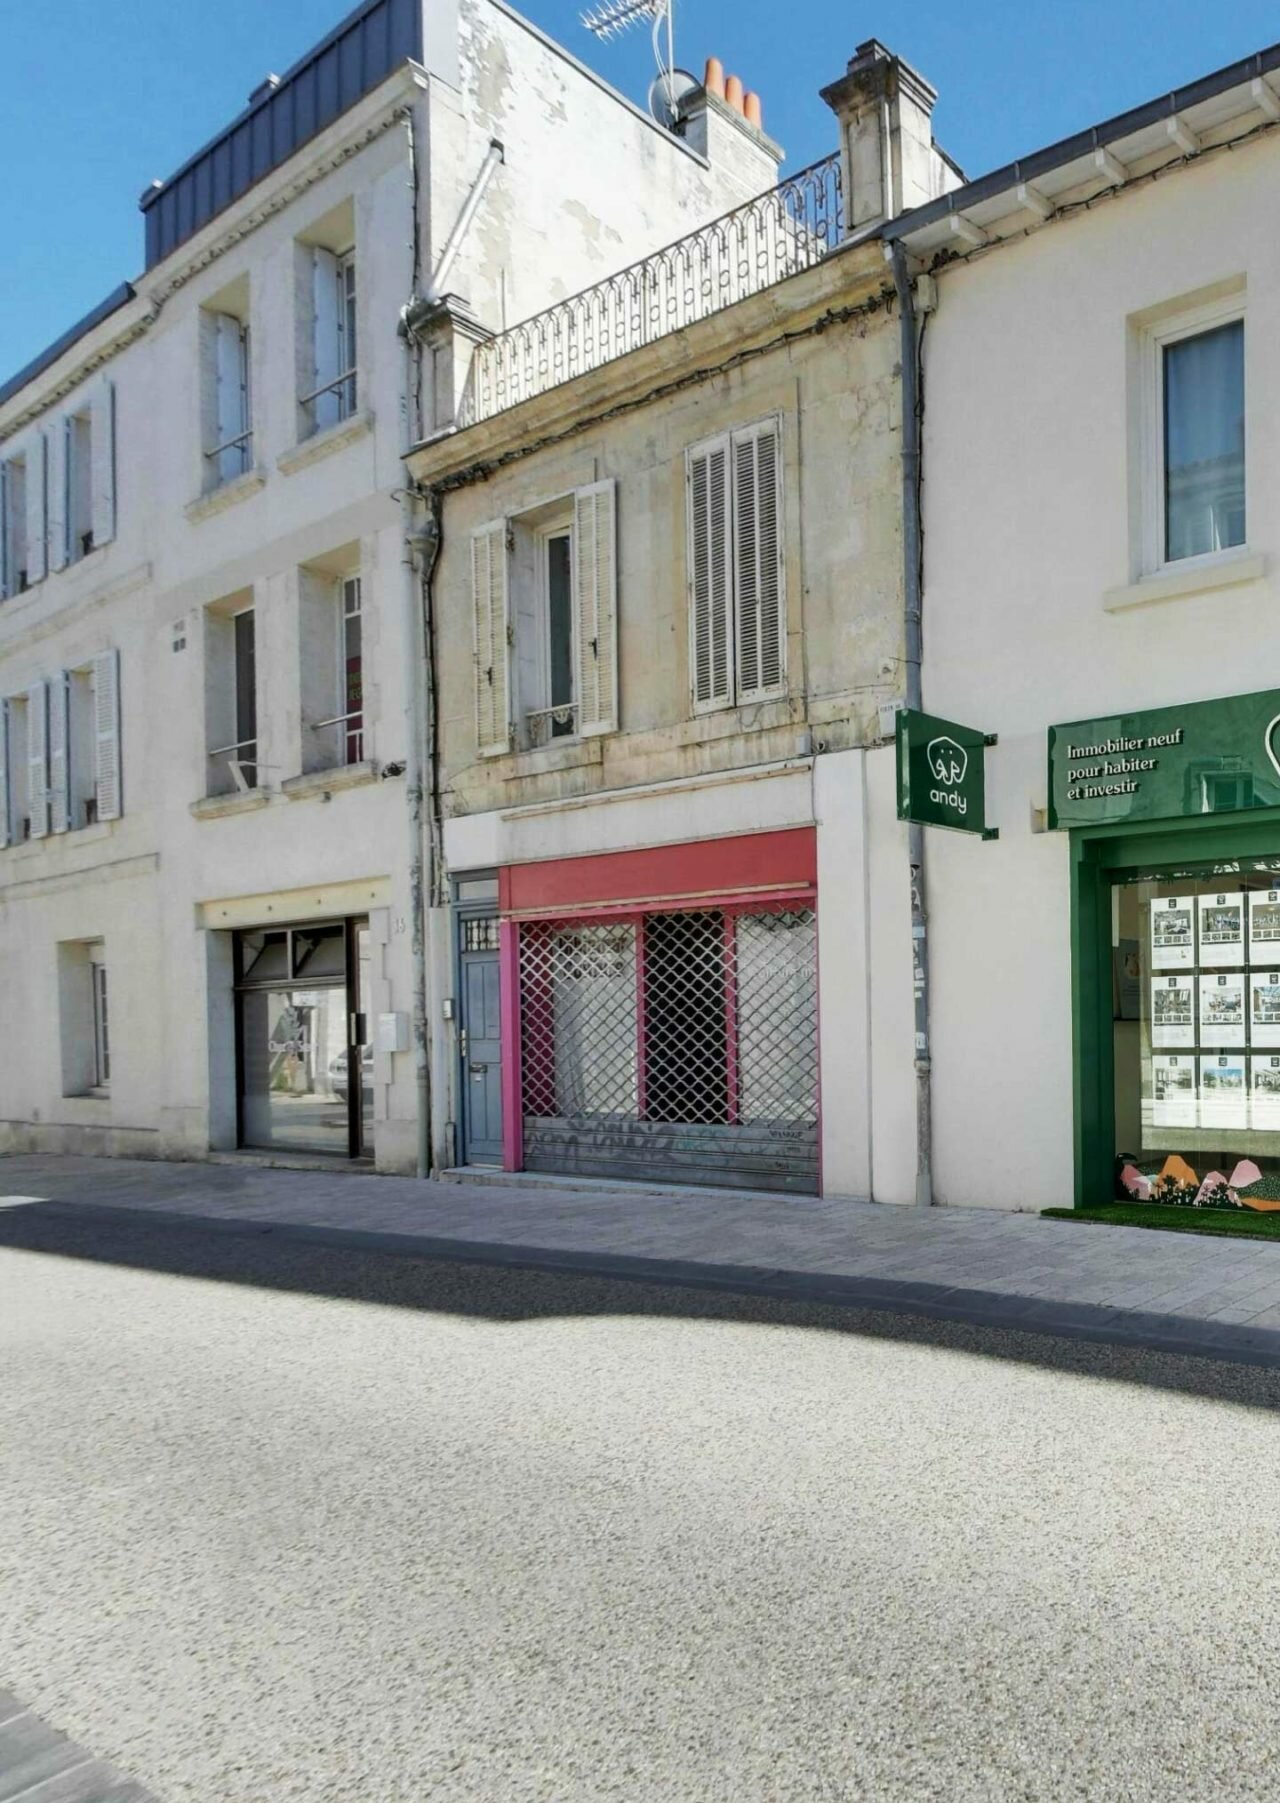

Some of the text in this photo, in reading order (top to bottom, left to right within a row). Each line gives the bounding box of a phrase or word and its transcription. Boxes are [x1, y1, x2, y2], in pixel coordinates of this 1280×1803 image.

[1067, 728, 1183, 759] Immobilier neuf
[1067, 758, 1156, 783] pour habiter
[930, 789, 967, 814] andy
[1067, 778, 1138, 800] et investir
